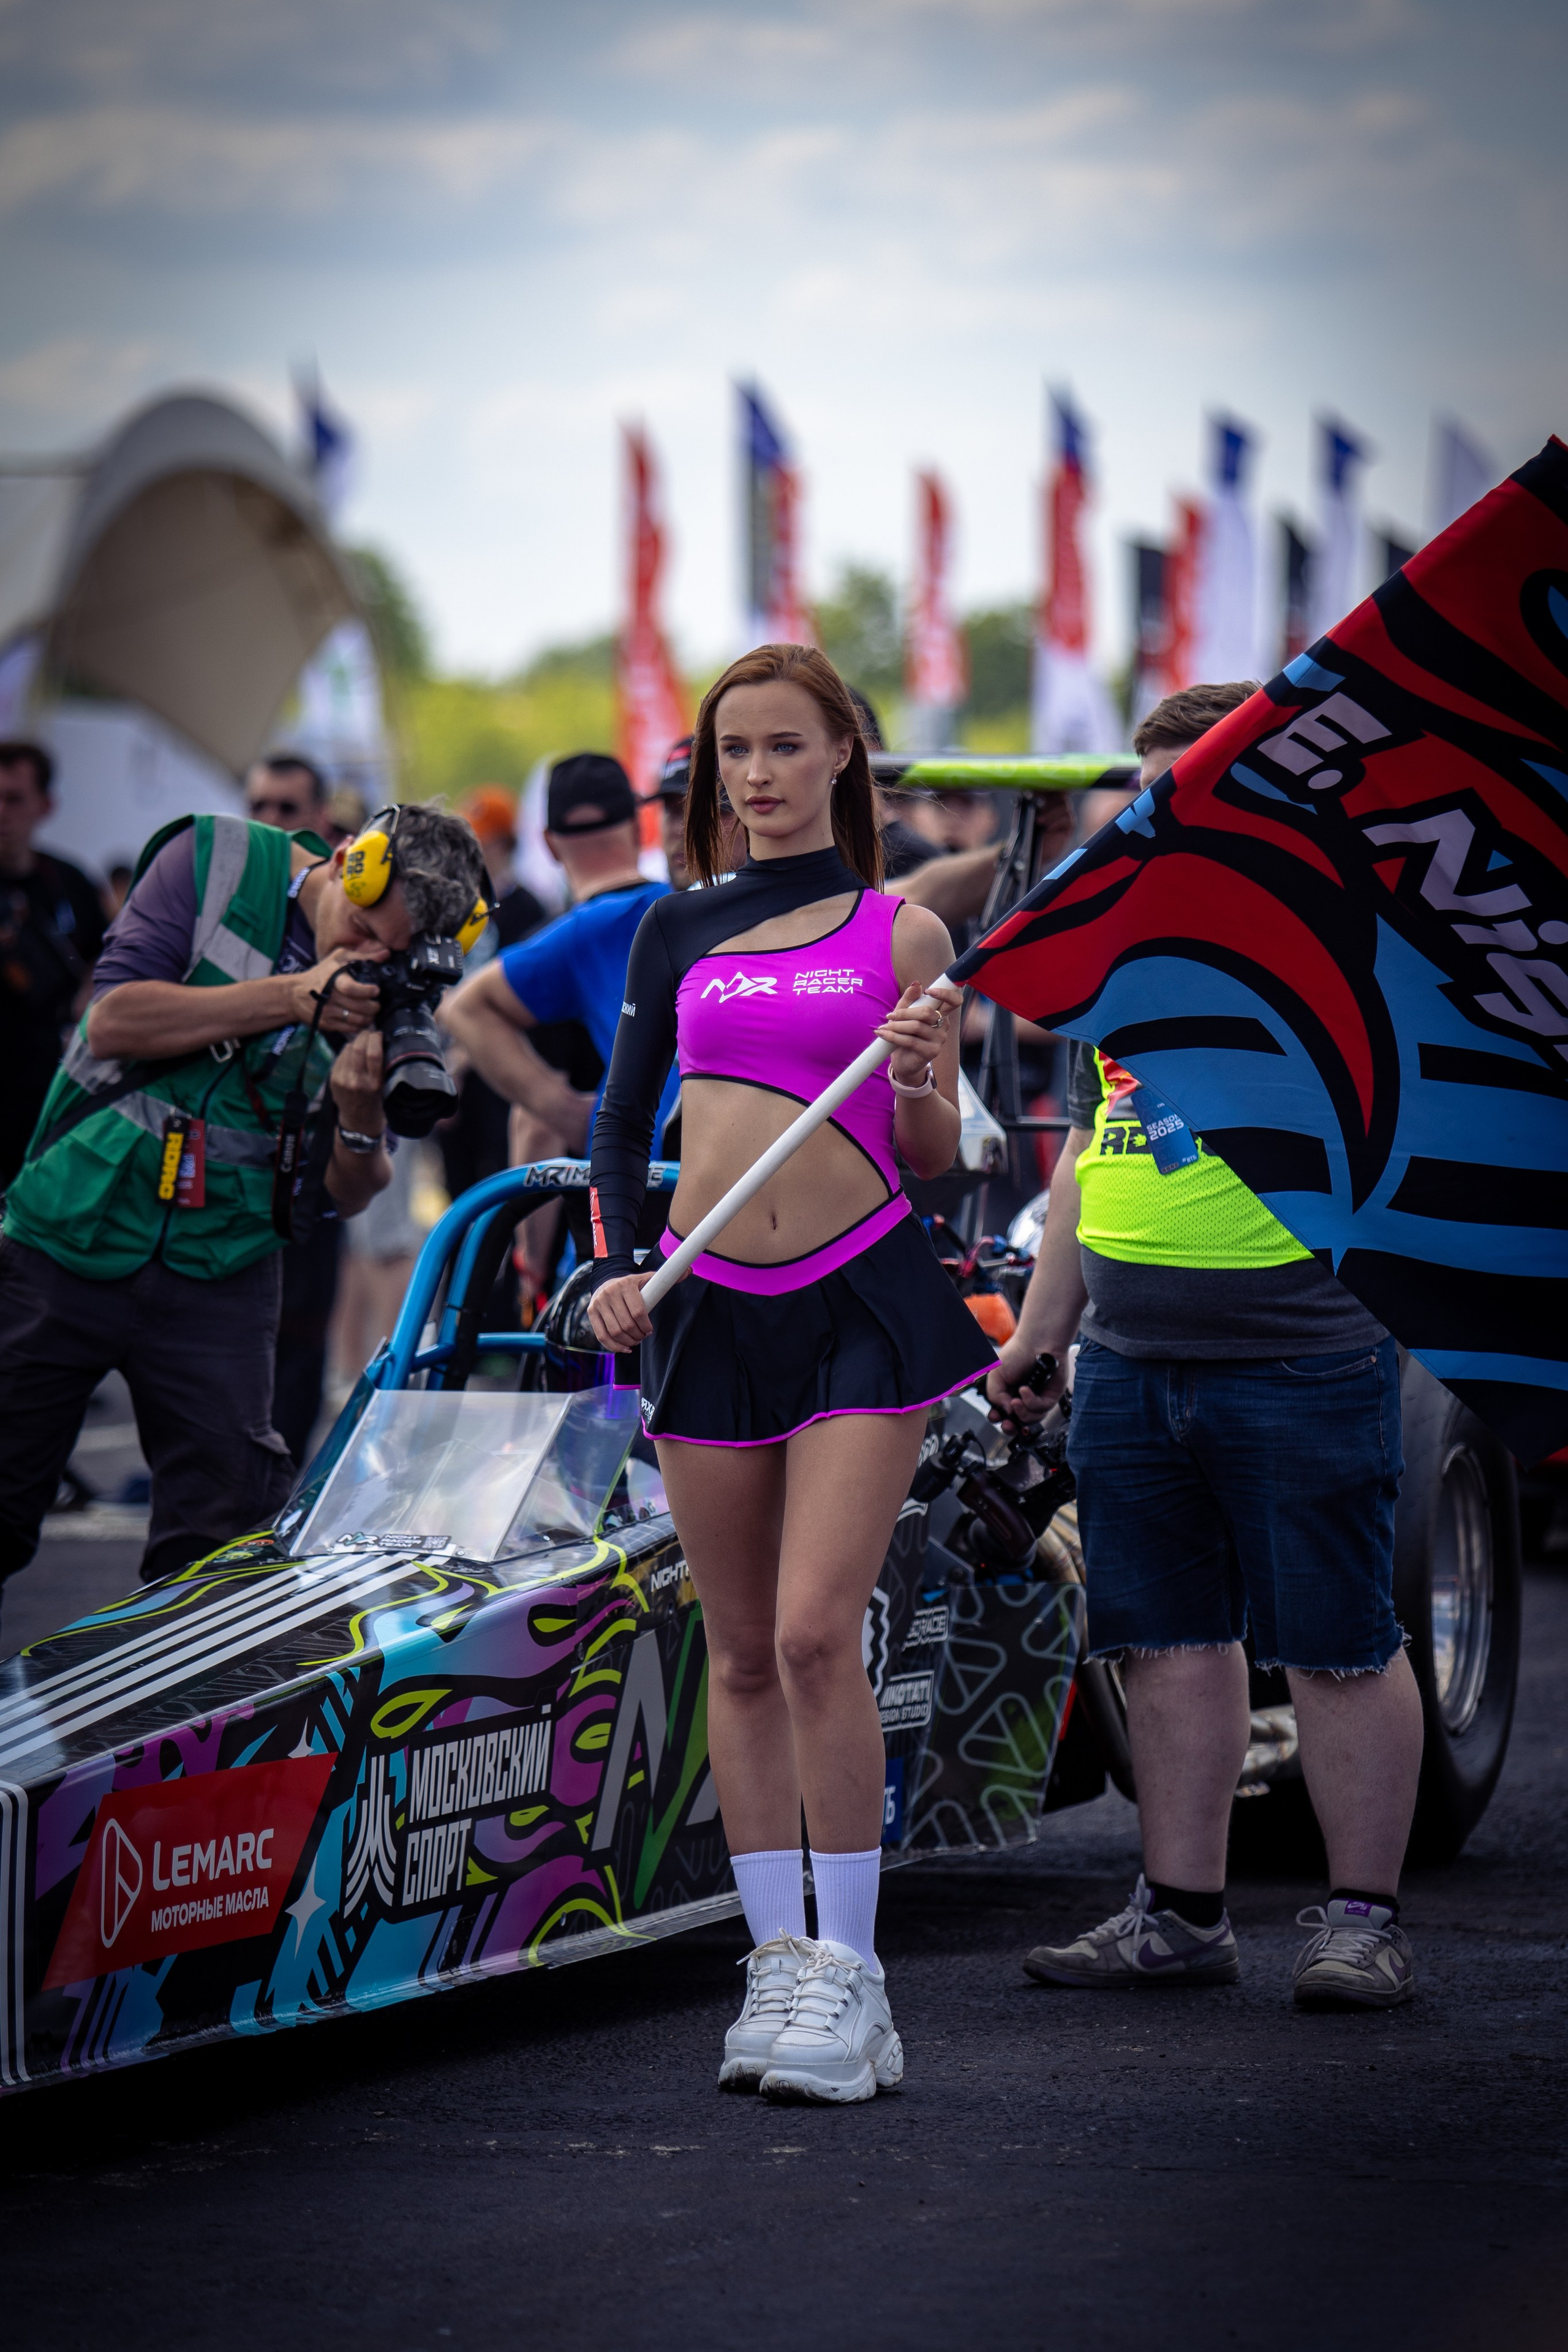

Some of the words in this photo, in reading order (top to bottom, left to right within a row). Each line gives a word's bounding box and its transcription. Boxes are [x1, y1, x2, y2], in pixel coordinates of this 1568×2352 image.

[793, 978, 863, 987] RACER
[795, 969, 854, 980] NIGHT
[792, 985, 854, 995] TEAM
[1148, 1120, 1185, 1141] 2025
[650, 1559, 690, 1593] NIGHT
[880, 1708, 900, 1724] ESIGN
[900, 1703, 928, 1722] STUDIO
[410, 1704, 551, 1823] МОСКОВСКИЙ
[152, 1828, 275, 1891] LEMARC
[402, 1819, 472, 1906] СПОРТ
[151, 1894, 224, 1932] МОТОРНЫЕ
[225, 1887, 270, 1912] МАСЛА
